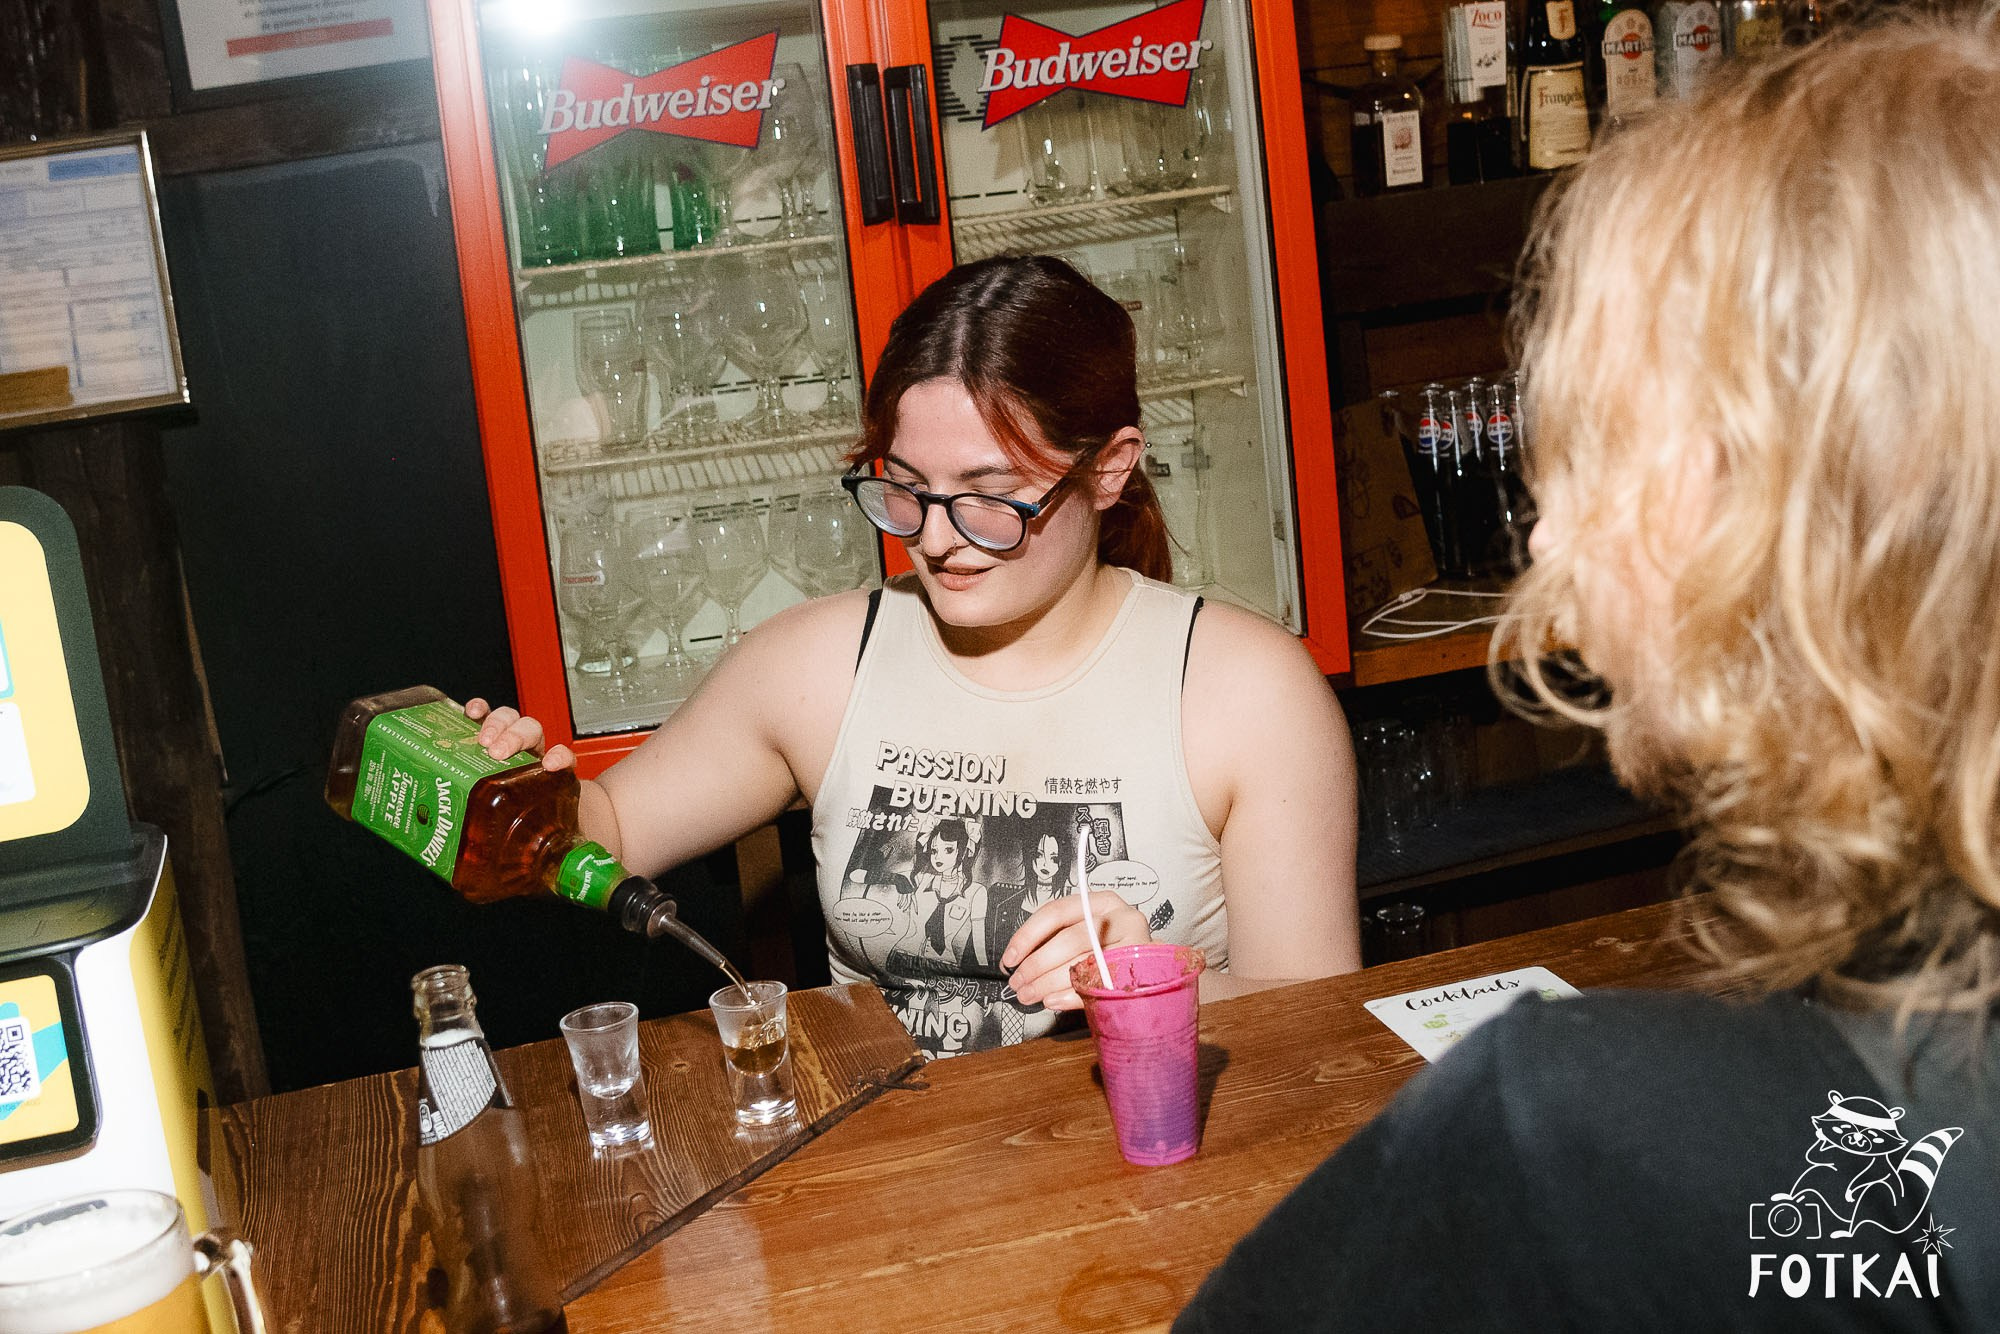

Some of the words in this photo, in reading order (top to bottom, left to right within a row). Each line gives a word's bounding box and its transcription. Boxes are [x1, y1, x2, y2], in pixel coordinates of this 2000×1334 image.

[977, 35, 1214, 93] Budweiser
[537, 75, 786, 134] Budweiser
[875, 740, 1007, 784] PASSION
[1044, 777, 1122, 795] 情熱を燃やす
[384, 767, 402, 823] APPLE
[393, 771, 413, 829] Tennessee
[435, 777, 452, 816] JACK
[889, 779, 1038, 819] BURNING
[419, 815, 454, 867] DANIEL'S
[1405, 979, 1520, 1011] Cocktails
